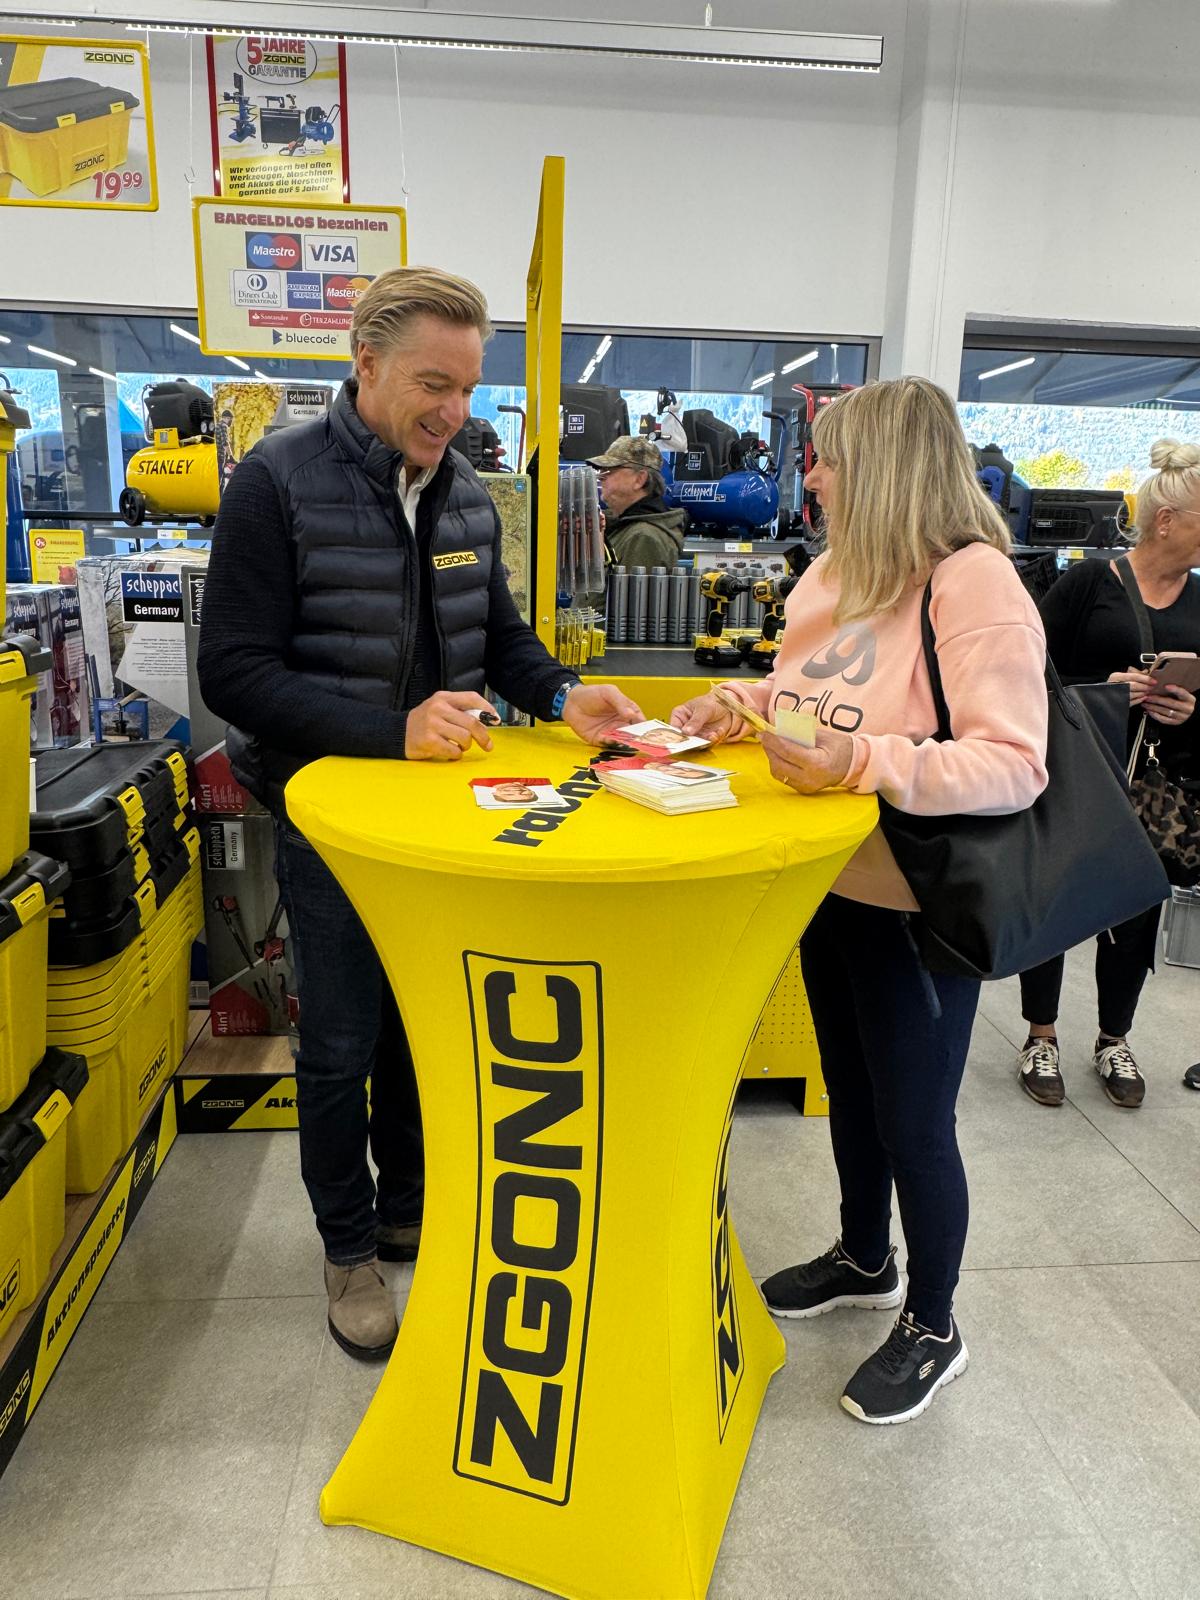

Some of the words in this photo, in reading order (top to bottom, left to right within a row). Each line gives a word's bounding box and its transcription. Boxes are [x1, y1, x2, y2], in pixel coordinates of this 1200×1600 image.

[85, 52, 135, 63] ZGONC
[247, 37, 263, 65] 5
[262, 37, 306, 54] JAHRE
[263, 54, 305, 64] ZGONC
[248, 64, 307, 78] GARANTIE
[74, 154, 105, 172] ZGONC
[229, 166, 243, 174] Wir
[295, 162, 308, 170] bei
[286, 169, 333, 178] Maschinen
[229, 181, 246, 189] und
[248, 180, 274, 188] Akkus
[238, 187, 277, 197] garantie
[278, 186, 294, 194] auf
[213, 211, 315, 230] BARGELDLOS
[317, 216, 389, 232] bezahlen
[253, 245, 296, 257] Maestro
[308, 244, 356, 263] VISA
[238, 290, 261, 299] Diners
[261, 291, 278, 299] Club
[285, 332, 338, 345] bluecode
[289, 391, 323, 405] scheppach
[293, 408, 319, 416] Germany
[137, 459, 195, 475] STANLEY
[434, 553, 477, 568] ZGONC
[134, 603, 180, 618] Germany
[230, 831, 239, 862] Germany
[138, 1046, 167, 1101] ZGONC
[203, 1099, 244, 1108] ZGONC
[470, 970, 584, 1484] ZGONC
[46, 1197, 126, 1352] Aktionspalette
